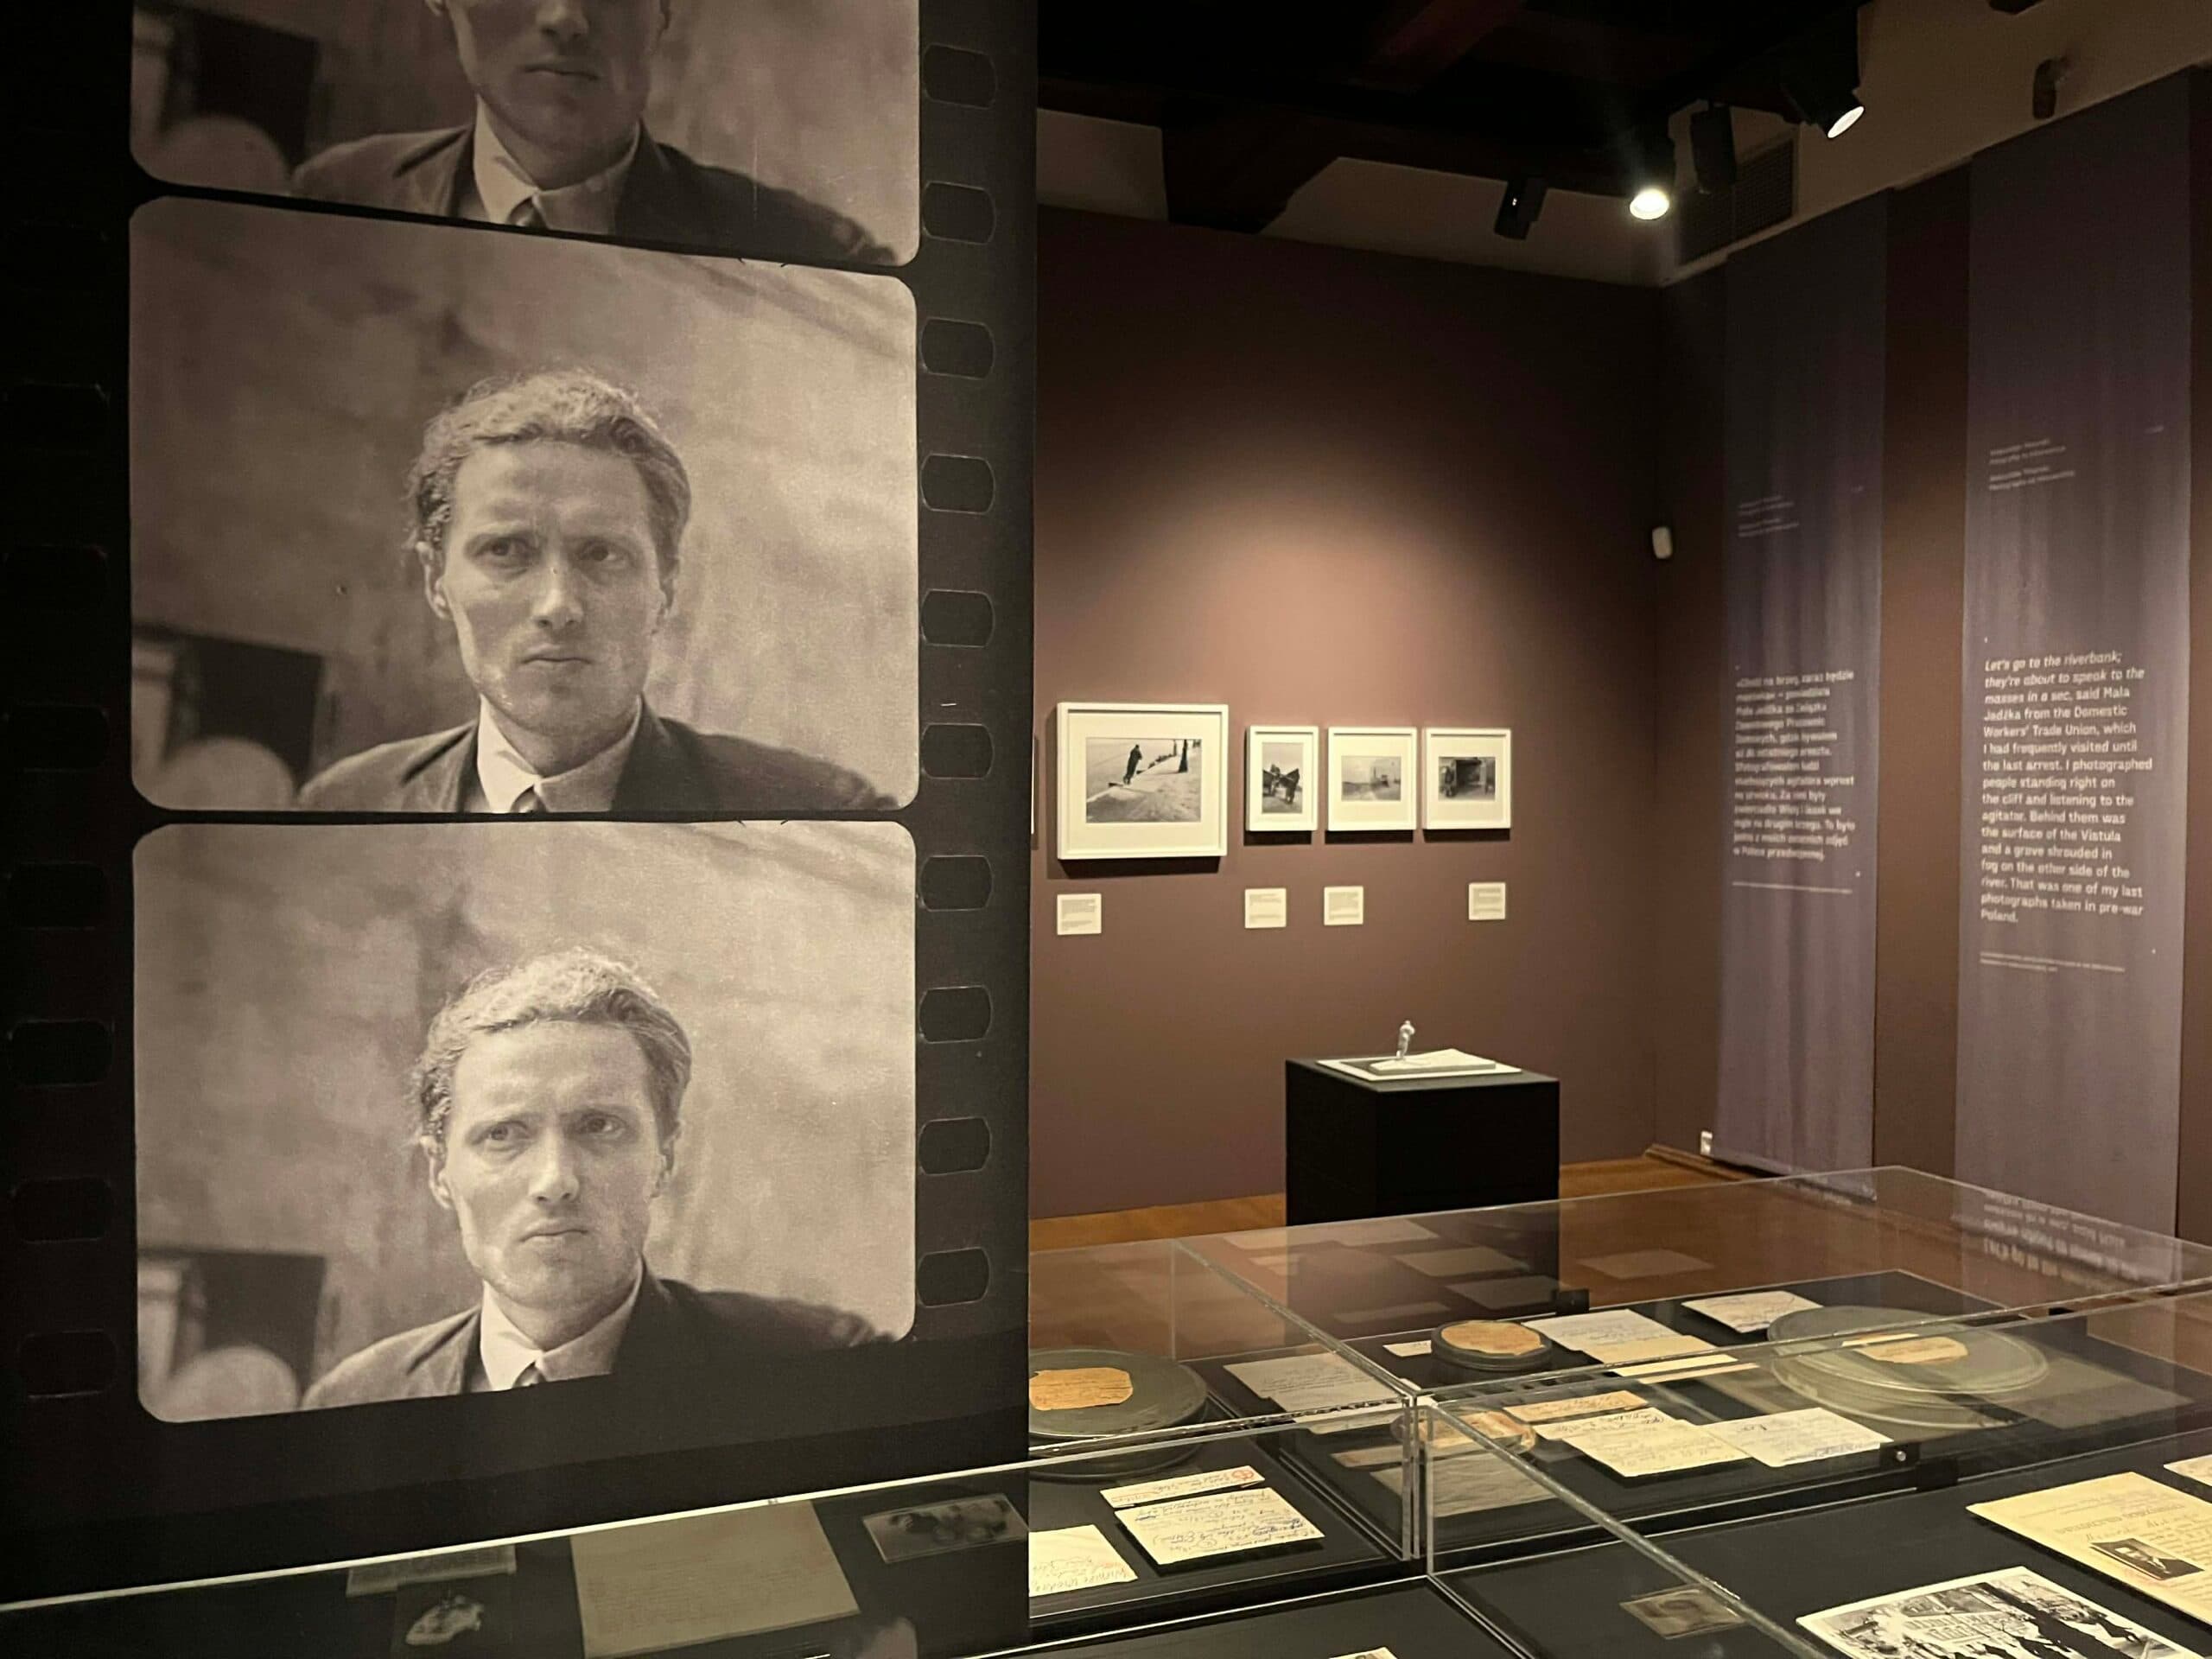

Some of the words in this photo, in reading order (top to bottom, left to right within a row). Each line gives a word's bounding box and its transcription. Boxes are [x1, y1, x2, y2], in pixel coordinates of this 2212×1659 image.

[2012, 659, 2026, 672] go
[2029, 658, 2041, 669] to
[2044, 655, 2061, 667] the
[1985, 676, 2020, 689] they're
[2024, 674, 2056, 686] about
[2058, 673, 2069, 683] to
[2073, 670, 2107, 685] speak
[2111, 670, 2123, 680] to
[2126, 666, 2145, 679] the
[1985, 694, 2024, 704] masses
[2027, 691, 2037, 702] in
[2076, 688, 2100, 700] said
[2024, 708, 2050, 719] from
[2054, 708, 2071, 718] the
[2075, 705, 2128, 718] Domestic
[2033, 723, 2062, 736] Trade
[2065, 724, 2100, 736] Union,
[2103, 721, 2136, 734] which
[1990, 742, 2010, 753] had
[2013, 741, 2067, 756] frequently
[2070, 740, 2109, 753] visited
[2113, 740, 2138, 752] until
[1983, 760, 1999, 771] the
[2003, 760, 2023, 771] last
[2073, 757, 2152, 772] photographed
[1983, 776, 2017, 790] people
[2019, 776, 2067, 791] standing
[2070, 776, 2096, 791] right
[2101, 779, 2115, 788] on
[1982, 793, 1999, 804] the
[2002, 793, 2023, 804] cliff
[2025, 793, 2047, 805] and
[2050, 792, 2096, 809] listening
[2100, 795, 2113, 806] to
[2115, 793, 2134, 806] the
[2030, 810, 2065, 823] Behind
[2069, 811, 2099, 823] them
[2102, 814, 2126, 823] was
[1981, 827, 1999, 837] the
[2002, 827, 2044, 839] surface
[2046, 828, 2057, 839] of
[2060, 829, 2077, 840] the
[2082, 830, 2121, 842] Vistula
[1981, 842, 2002, 855] and
[2048, 846, 2098, 859] shrouded
[2102, 848, 2113, 859] in
[1981, 859, 1999, 874] fog
[2001, 861, 2014, 872] on
[2017, 861, 2035, 873] the
[2037, 863, 2065, 874] other
[2069, 864, 2093, 876] side
[2096, 864, 2108, 876] of
[2112, 866, 2130, 879] the
[2011, 878, 2034, 889] That
[2037, 881, 2059, 892] was
[2062, 883, 2082, 893] one
[2085, 882, 2098, 894] of
[2101, 886, 2119, 899] my
[2121, 885, 2143, 898] last
[1981, 894, 2048, 908] photographs
[2051, 899, 2082, 912] taken
[2085, 900, 2096, 912] in
